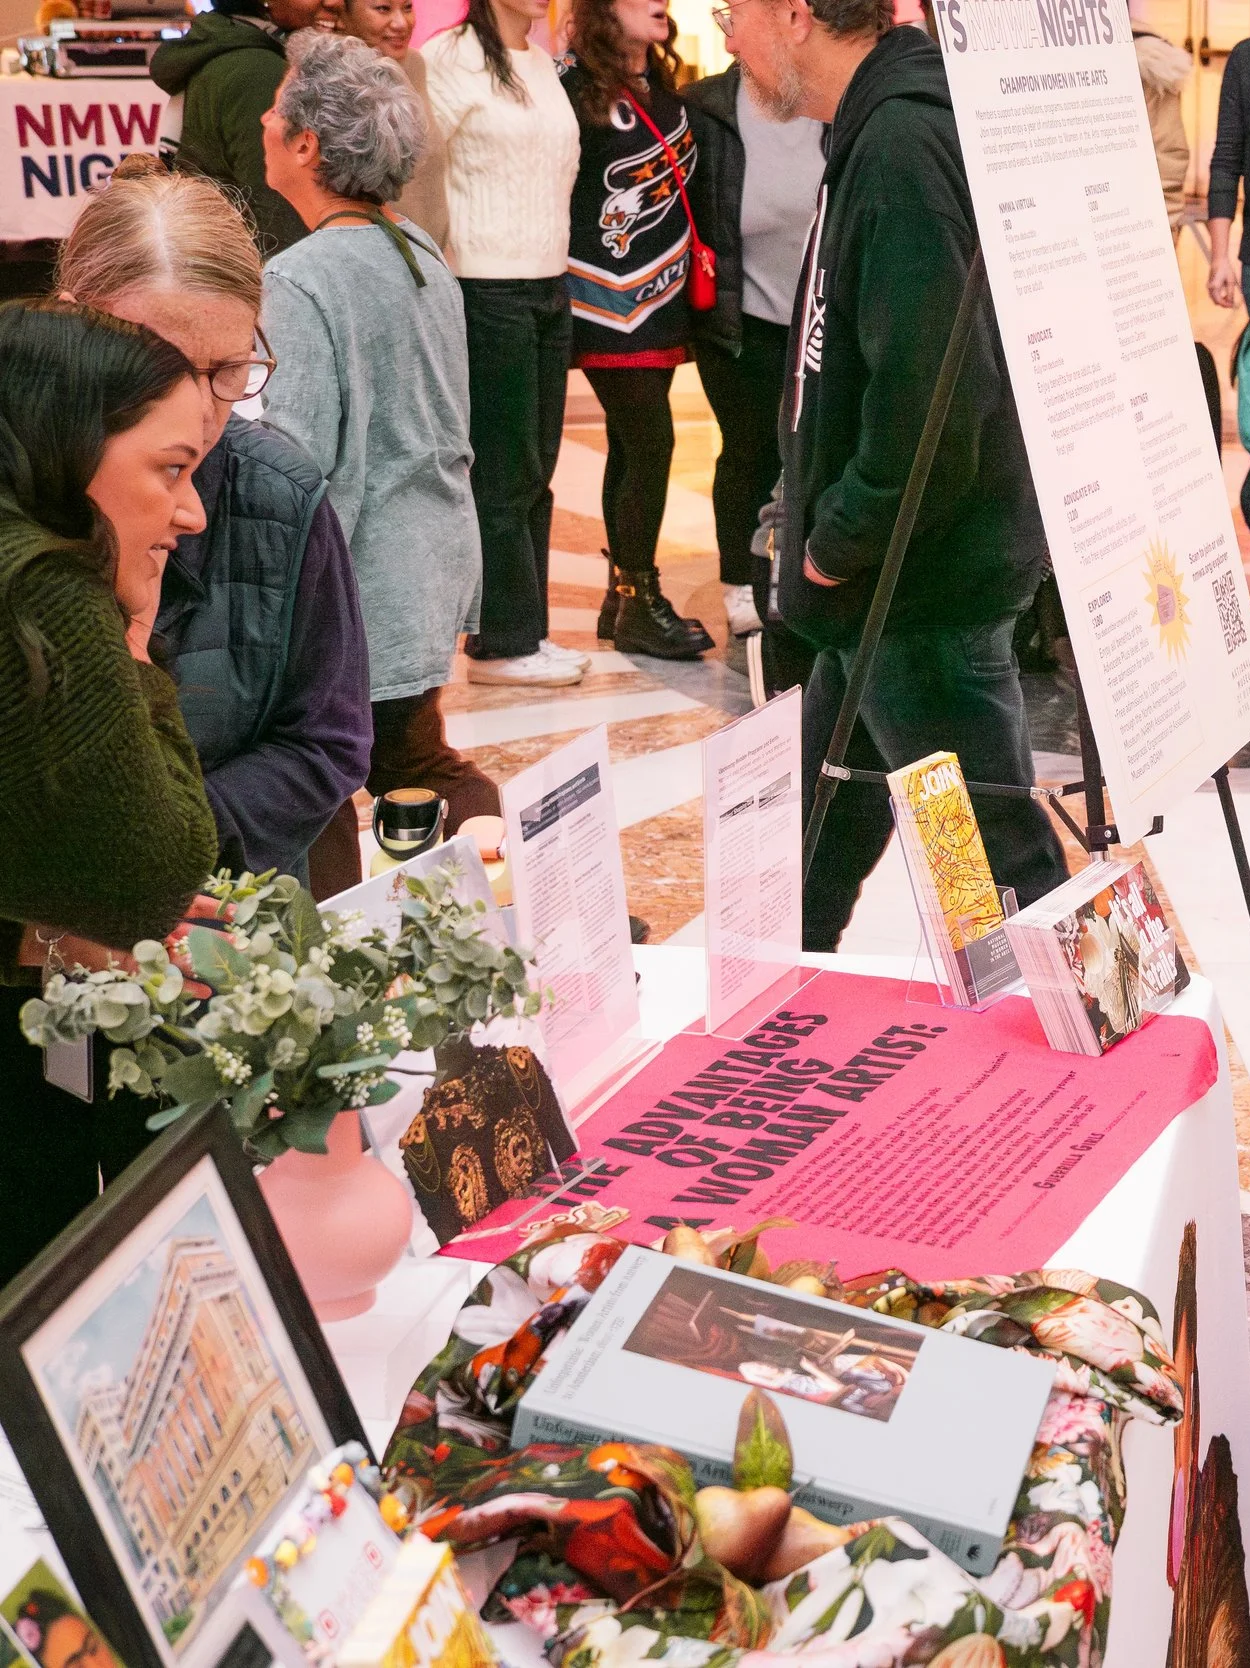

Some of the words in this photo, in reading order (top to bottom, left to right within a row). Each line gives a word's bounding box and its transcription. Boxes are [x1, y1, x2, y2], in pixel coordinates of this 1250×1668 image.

[1038, 0, 1113, 48] NIGHTS
[1000, 76, 1040, 94] CHAMPION
[1040, 73, 1068, 90] WOMEN
[1067, 73, 1077, 88] IN
[1076, 71, 1090, 87] THE
[1091, 70, 1108, 86] ARTS
[998, 202, 1016, 214] NMWA
[1015, 198, 1036, 210] VIRTUAL
[636, 258, 690, 303] CAPI
[1027, 328, 1052, 345] ADVOCATE
[1130, 393, 1148, 407] PARTNER
[1064, 487, 1088, 506] ADVOCATE
[1087, 481, 1100, 494] PLUS
[1189, 551, 1199, 565] Scan
[1199, 548, 1204, 559] to
[1203, 543, 1212, 557] join
[1211, 540, 1216, 551] or
[1216, 534, 1225, 547] visit
[1088, 591, 1112, 613] EXPLORER
[919, 762, 960, 800] JOIN
[1127, 881, 1147, 919] all
[1144, 914, 1170, 948] the
[602, 1010, 830, 1157] ADVANTAGES
[655, 1121, 736, 1168] OF
[702, 1057, 835, 1130] BEING
[671, 1103, 849, 1206] WOMAN
[813, 1022, 950, 1103] ARTIST:
[1071, 1133, 1105, 1151] GIRLS
[793, 1490, 855, 1516] ntwerp
